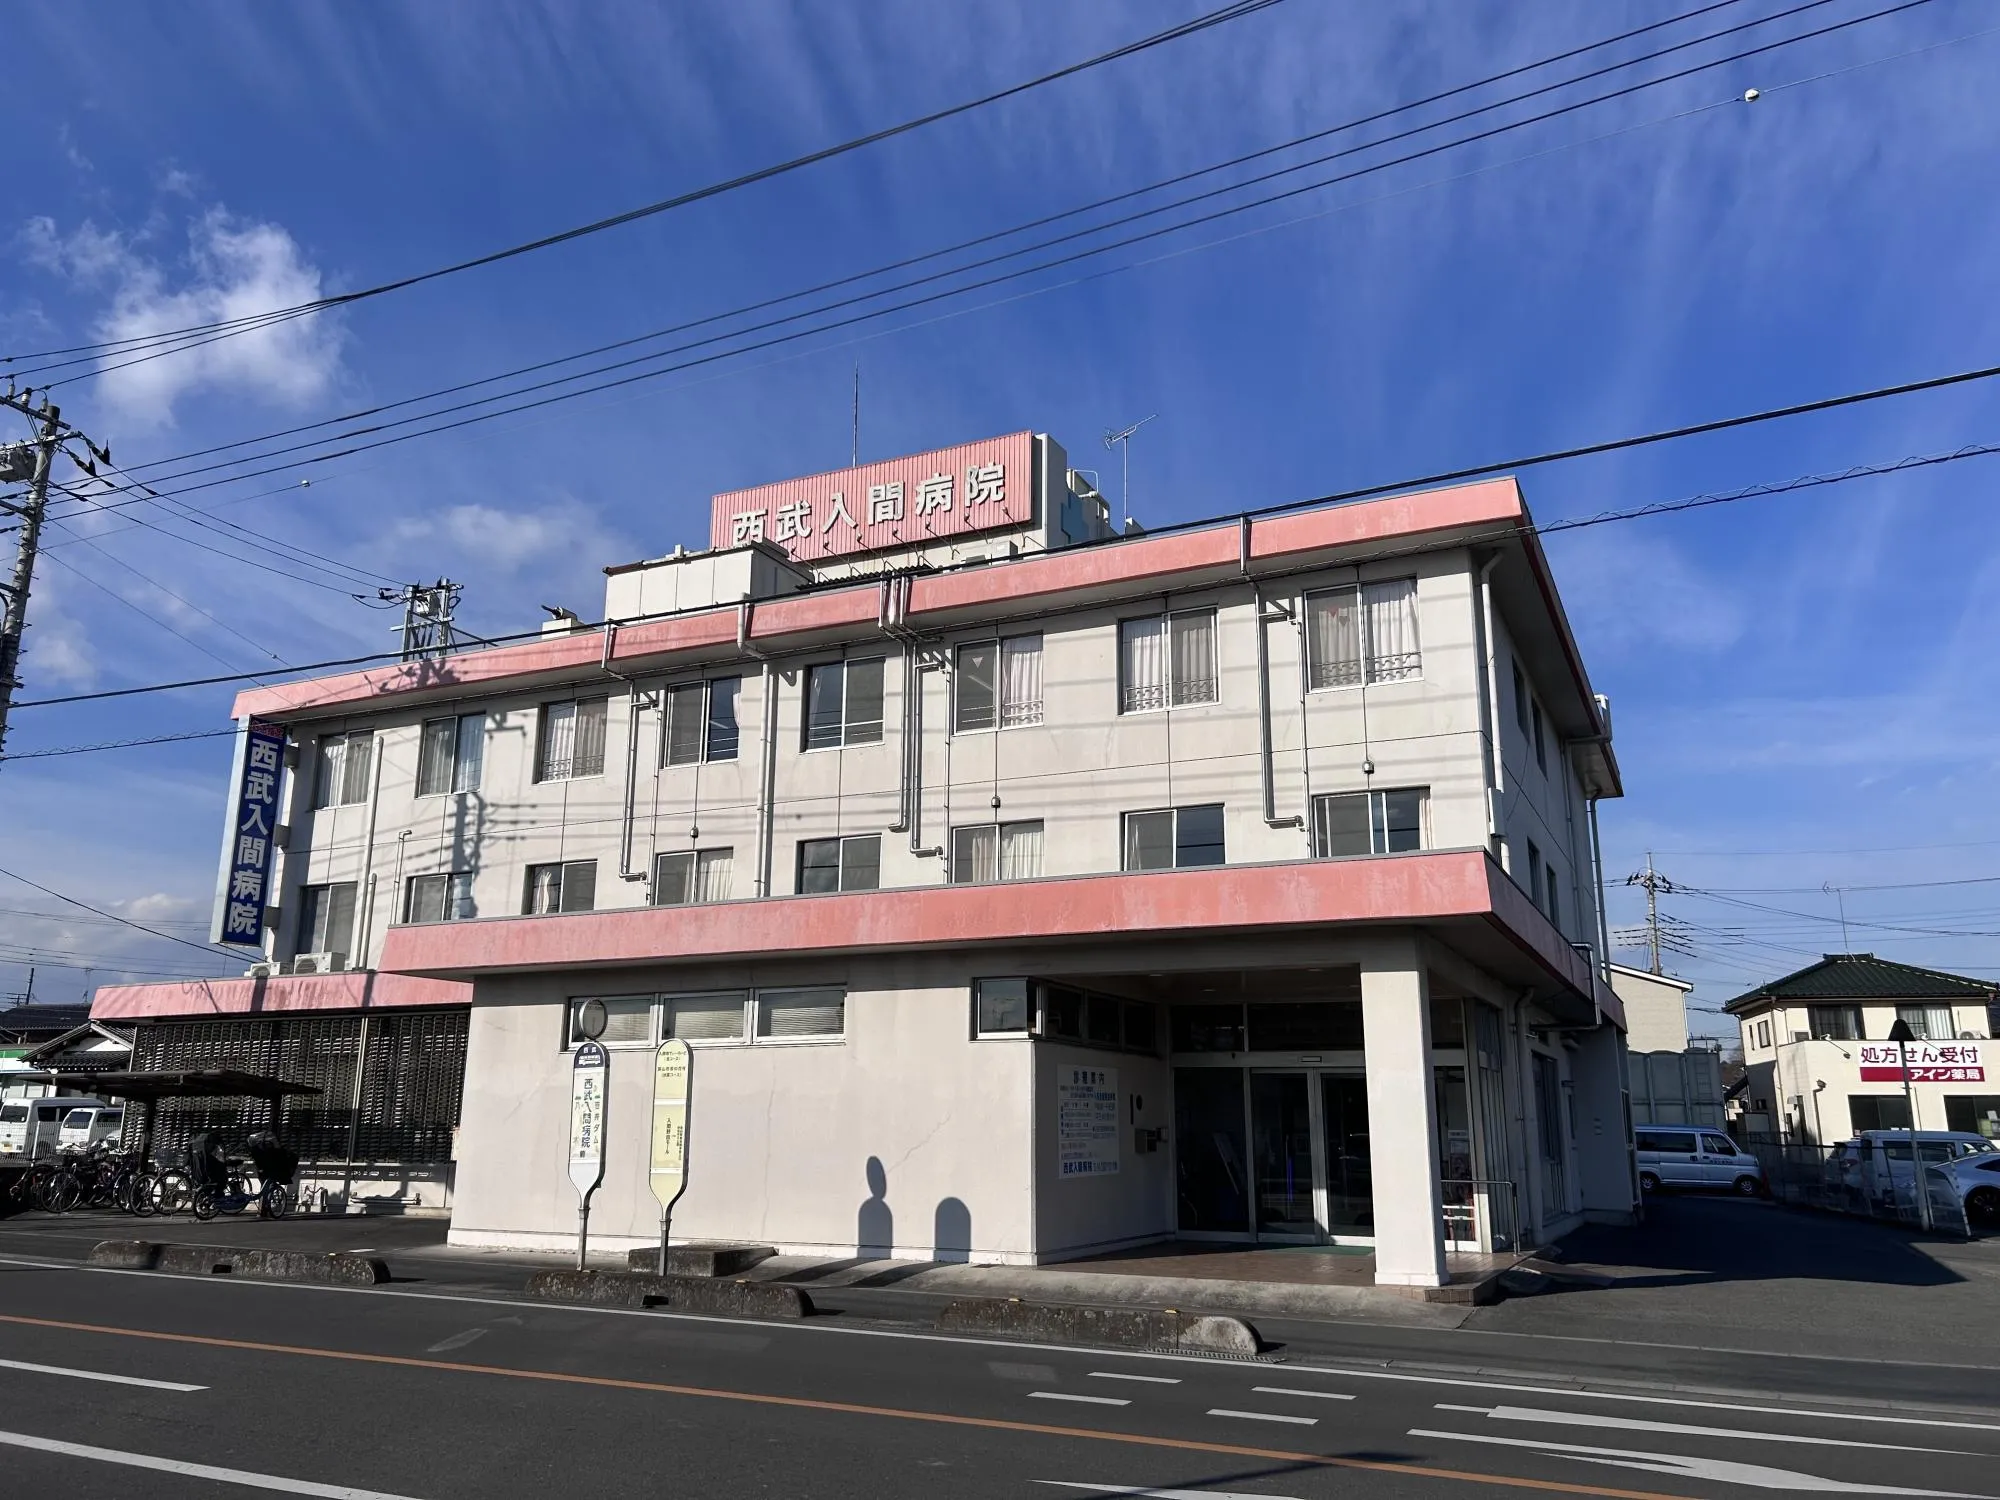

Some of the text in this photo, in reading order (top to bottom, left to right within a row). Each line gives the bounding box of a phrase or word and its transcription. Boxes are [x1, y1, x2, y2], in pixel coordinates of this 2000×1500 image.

[731, 463, 1005, 549] 西武入間病院
[228, 738, 279, 935] 西武入間病院
[1861, 1047, 1978, 1063] 処方せん受付
[1910, 1068, 1980, 1080] アイン薬局
